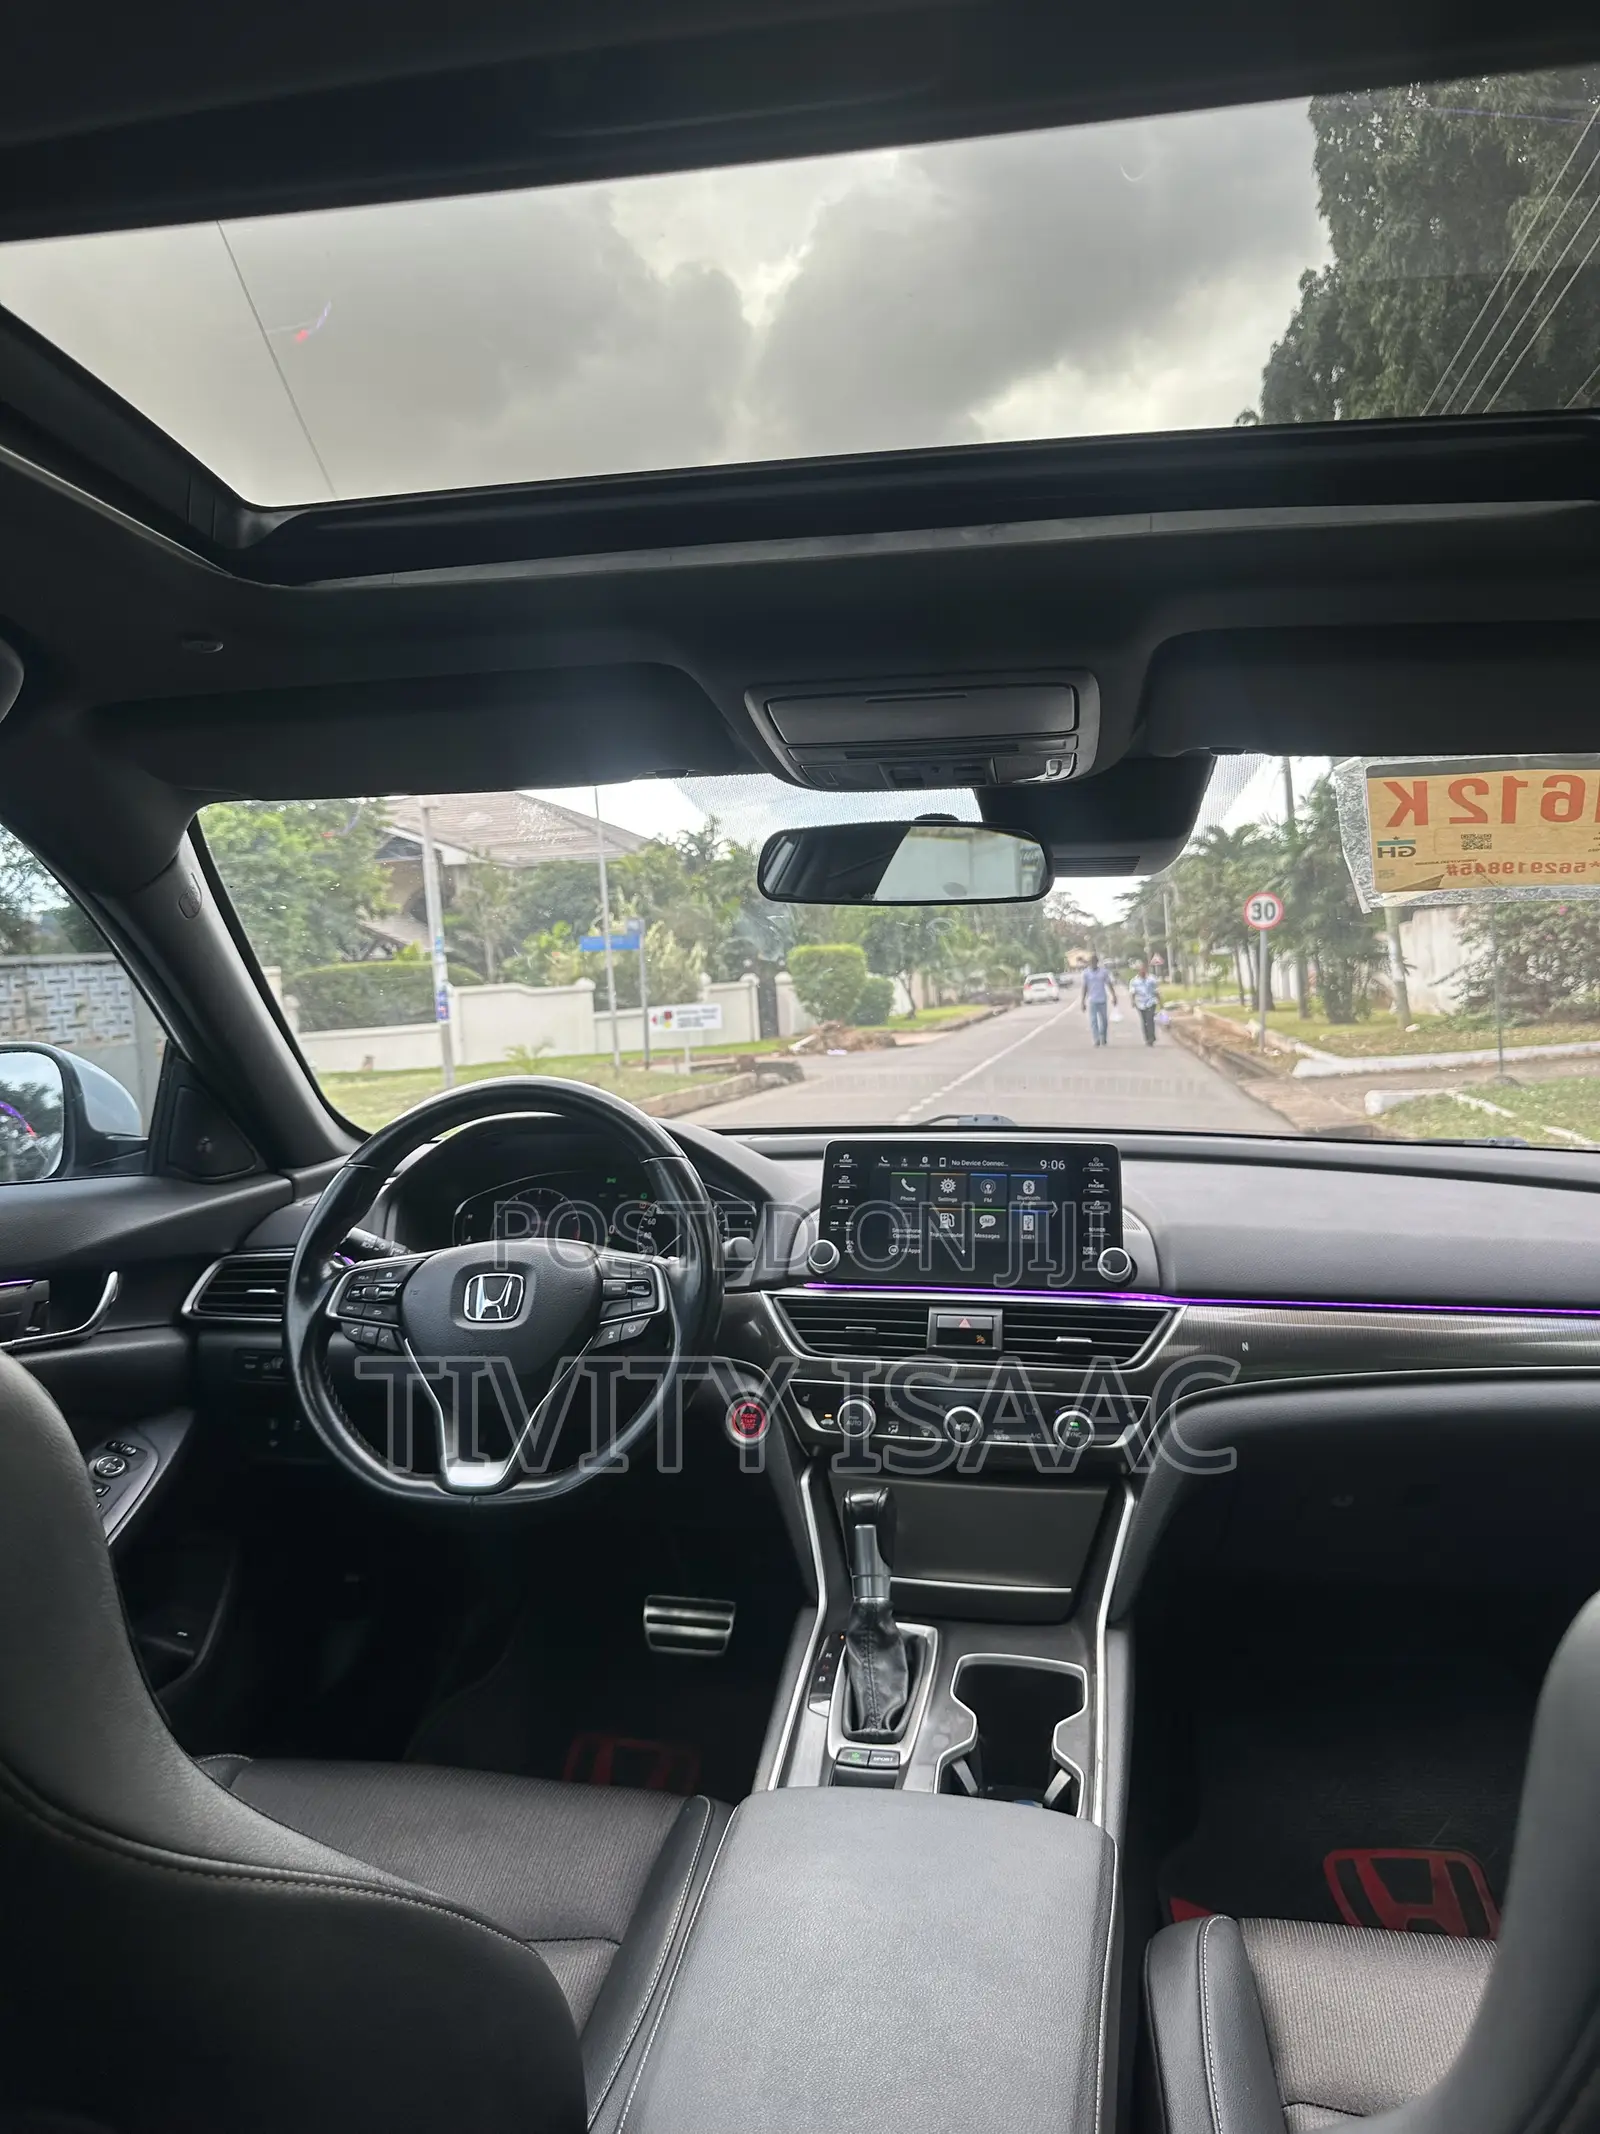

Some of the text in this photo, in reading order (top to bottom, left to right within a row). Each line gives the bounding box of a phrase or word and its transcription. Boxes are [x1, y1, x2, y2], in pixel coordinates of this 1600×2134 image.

[1251, 902, 1276, 921] 30
[1040, 1159, 1066, 1170] 9:06
[974, 1232, 1000, 1240] Messages
[846, 1419, 862, 1427] AUTO
